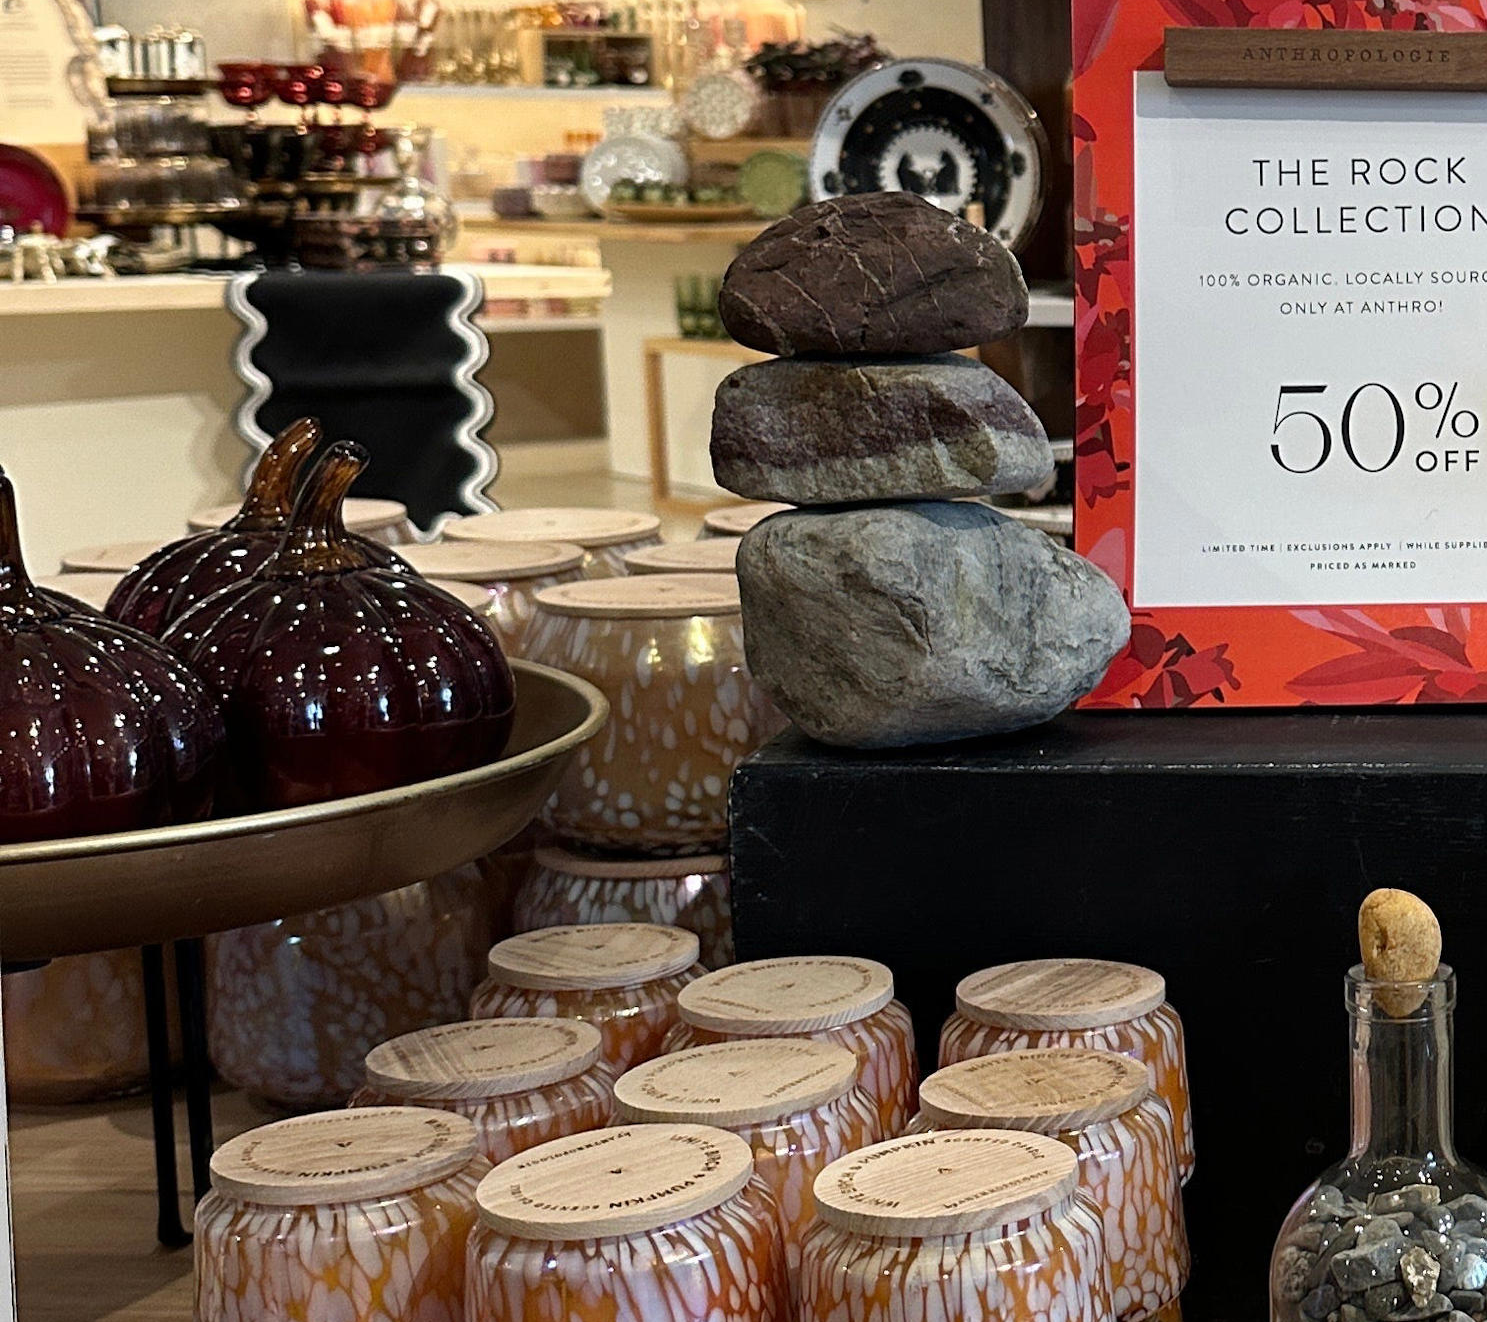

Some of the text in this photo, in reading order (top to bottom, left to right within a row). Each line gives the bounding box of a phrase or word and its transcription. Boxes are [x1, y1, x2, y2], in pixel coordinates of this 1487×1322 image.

[1242, 46, 1451, 64] ANTHROPOLOGIE
[1252, 156, 1467, 187] THE ROCK
[1199, 273, 1240, 287] 100%
[1345, 271, 1424, 286] LOCALLY
[1279, 299, 1443, 315] ONLY AT ANTHRO!
[1270, 381, 1480, 474] 50%
[1415, 449, 1480, 473] OFF
[1202, 544, 1246, 553] LIMITED
[1250, 544, 1275, 552] TIME
[1287, 543, 1355, 552] EXCLUSIONS
[1359, 542, 1392, 551] APPLY
[1406, 541, 1440, 550] WHILE
[1310, 561, 1417, 571] PRICED AS MARKED
[607, 1180, 695, 1209] PUMPKIN
